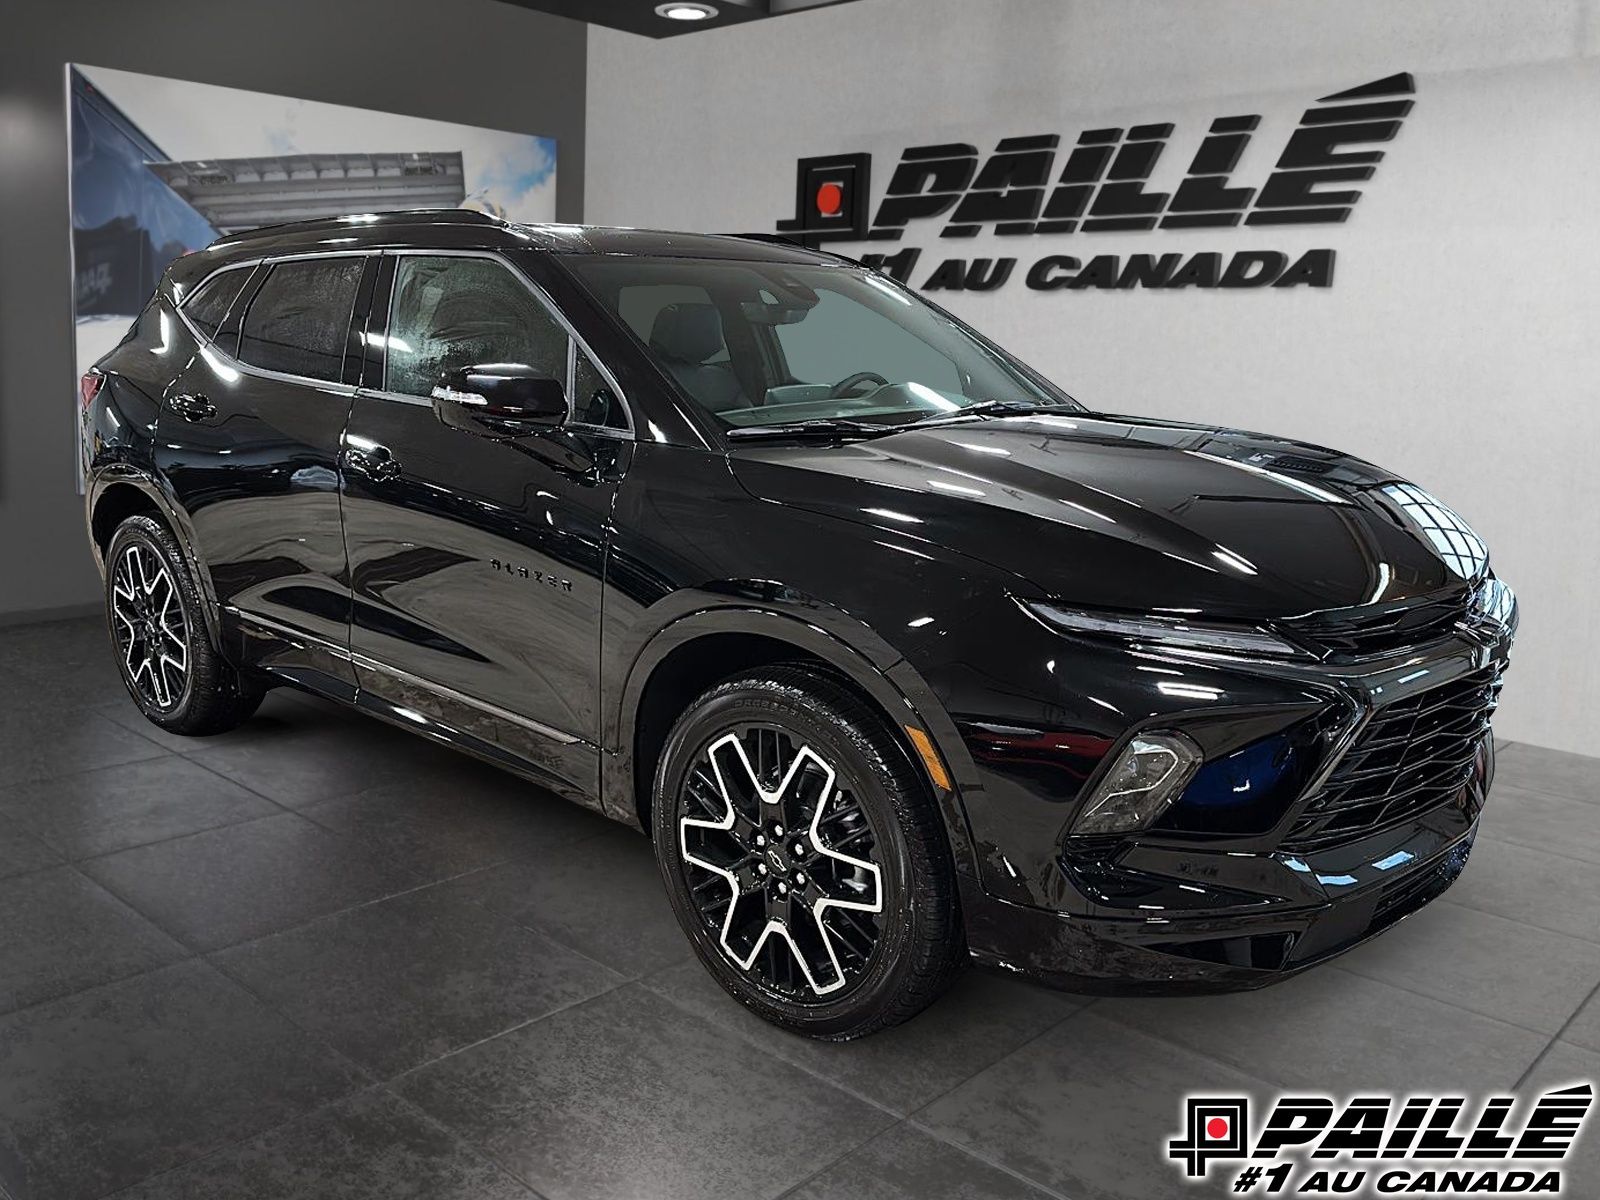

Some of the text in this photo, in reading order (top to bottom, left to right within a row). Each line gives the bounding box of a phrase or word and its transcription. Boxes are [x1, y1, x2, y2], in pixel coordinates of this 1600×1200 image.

[868, 72, 1415, 240] PAILLÉ
[921, 257, 1017, 290] AU
[1026, 249, 1336, 289] CANADA
[489, 557, 573, 592] BLAZER
